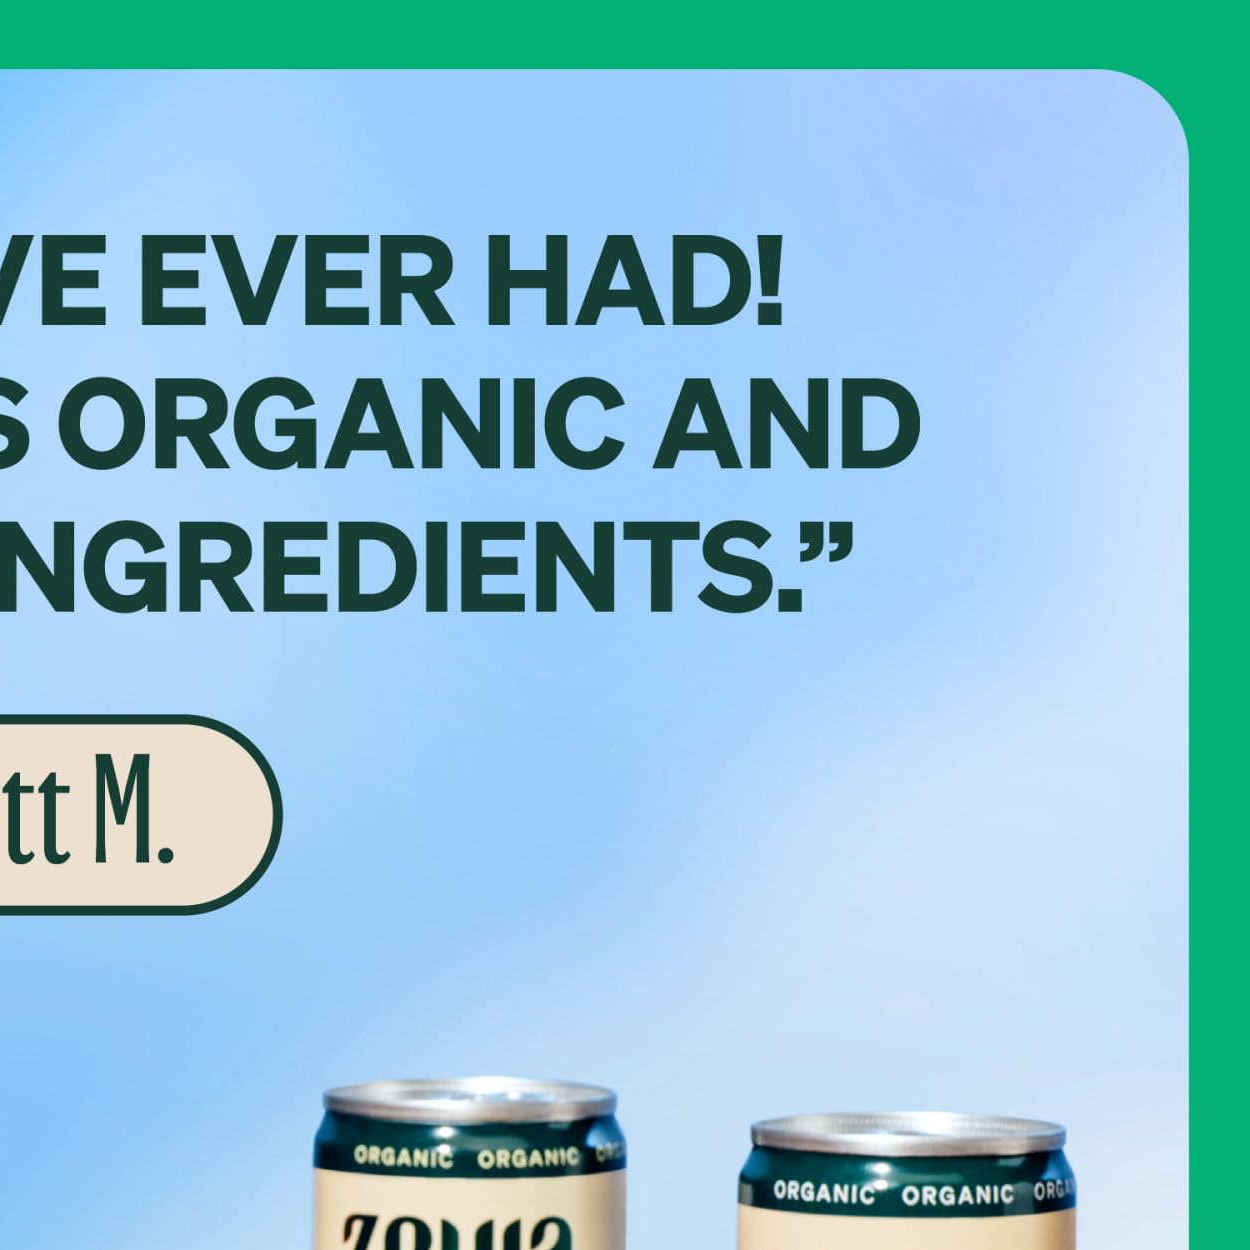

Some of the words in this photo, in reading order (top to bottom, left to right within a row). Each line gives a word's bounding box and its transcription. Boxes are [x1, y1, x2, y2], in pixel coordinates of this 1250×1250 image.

[354, 1144, 453, 1169] ORGANIC
[477, 1146, 580, 1170] ORGANIC
[774, 1180, 875, 1205] ORGANIC
[902, 1184, 1014, 1206] ORGANIC
